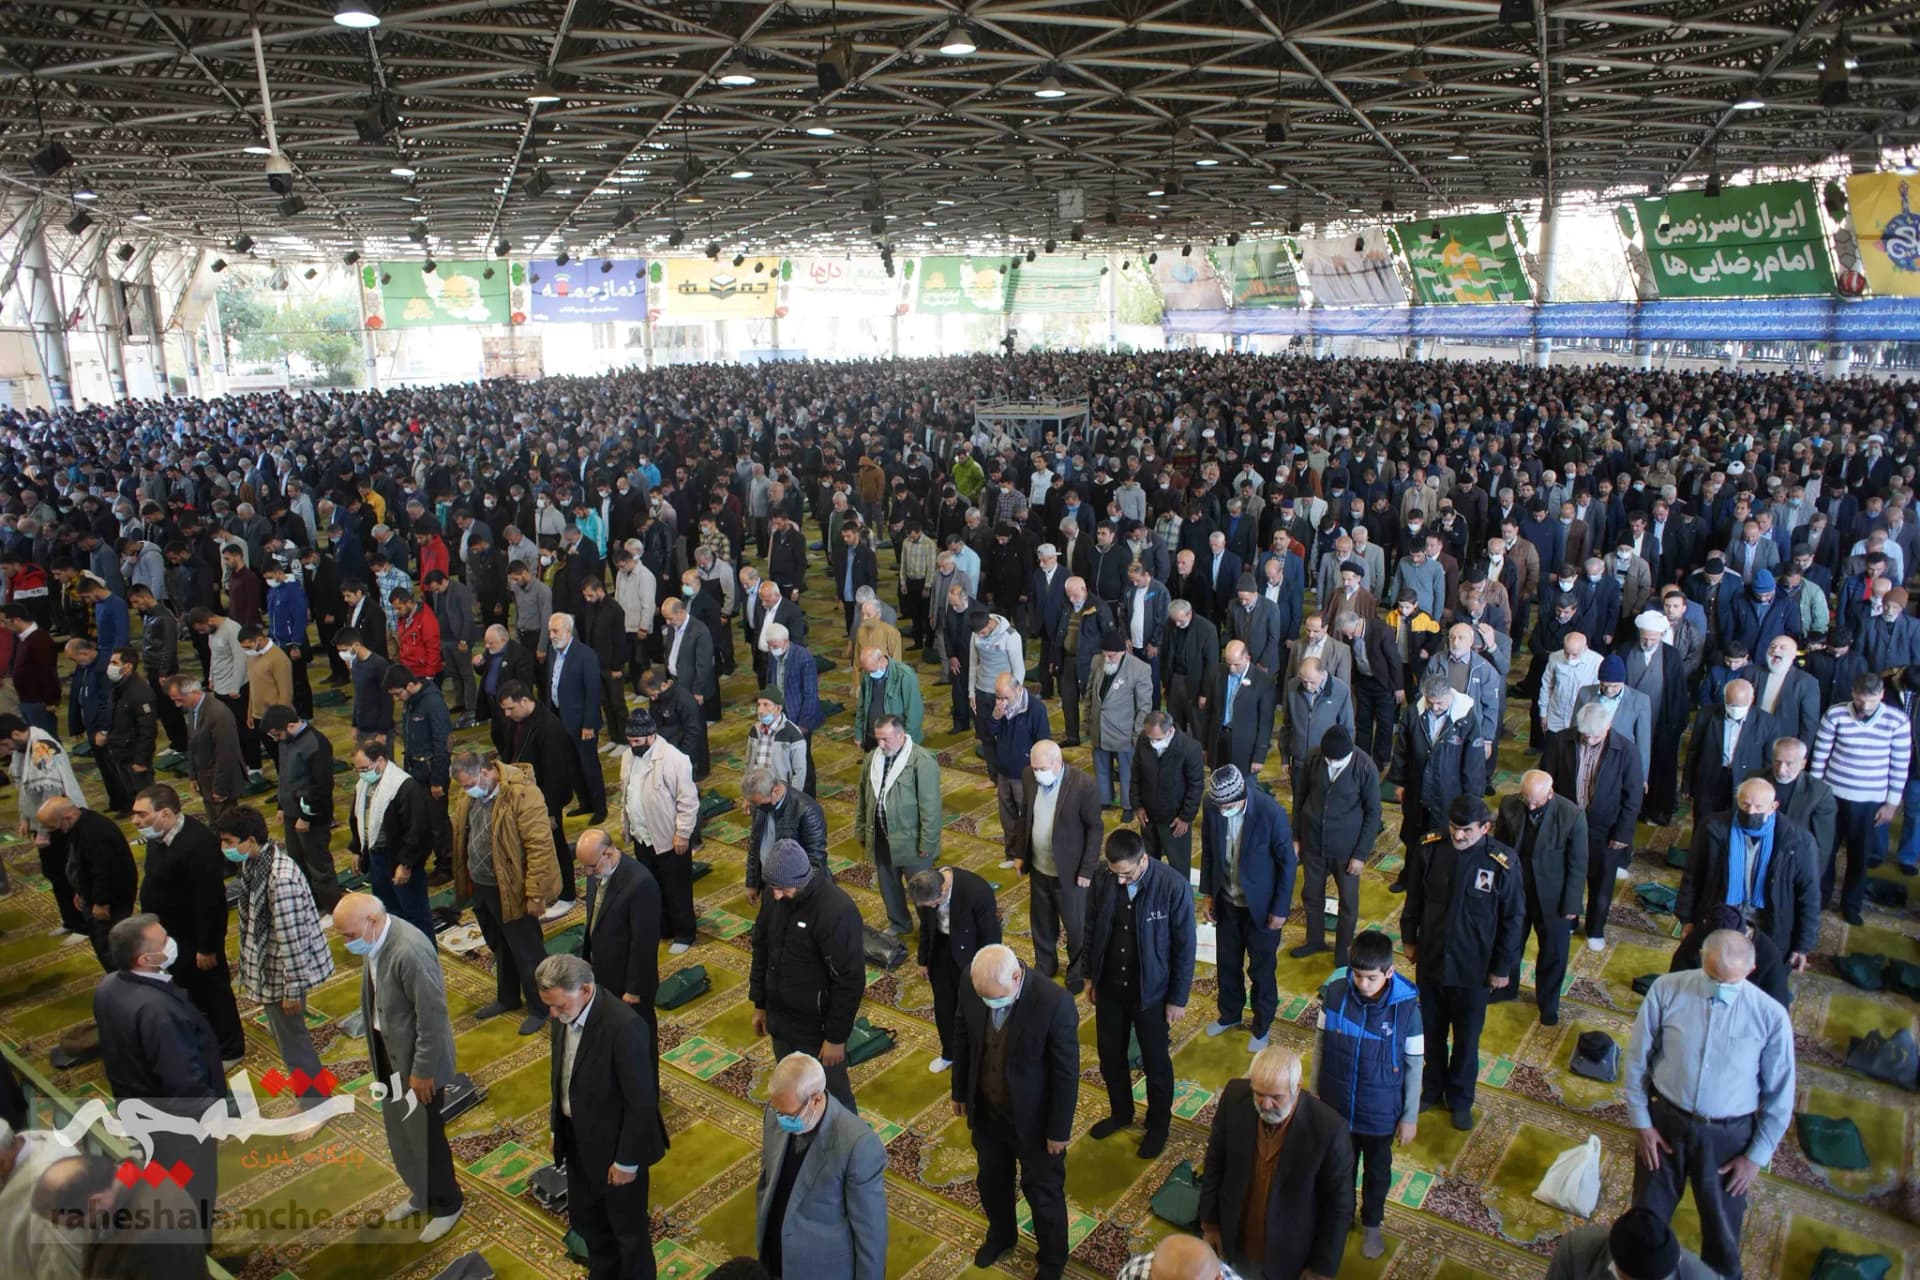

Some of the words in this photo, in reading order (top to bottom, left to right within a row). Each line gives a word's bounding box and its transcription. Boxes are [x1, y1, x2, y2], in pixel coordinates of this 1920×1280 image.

[1654, 213, 1740, 246] سرزمین
[1741, 199, 1806, 238] ایران
[1690, 249, 1764, 283] رضایی
[1763, 244, 1815, 283] امام
[599, 280, 636, 301] نماز
